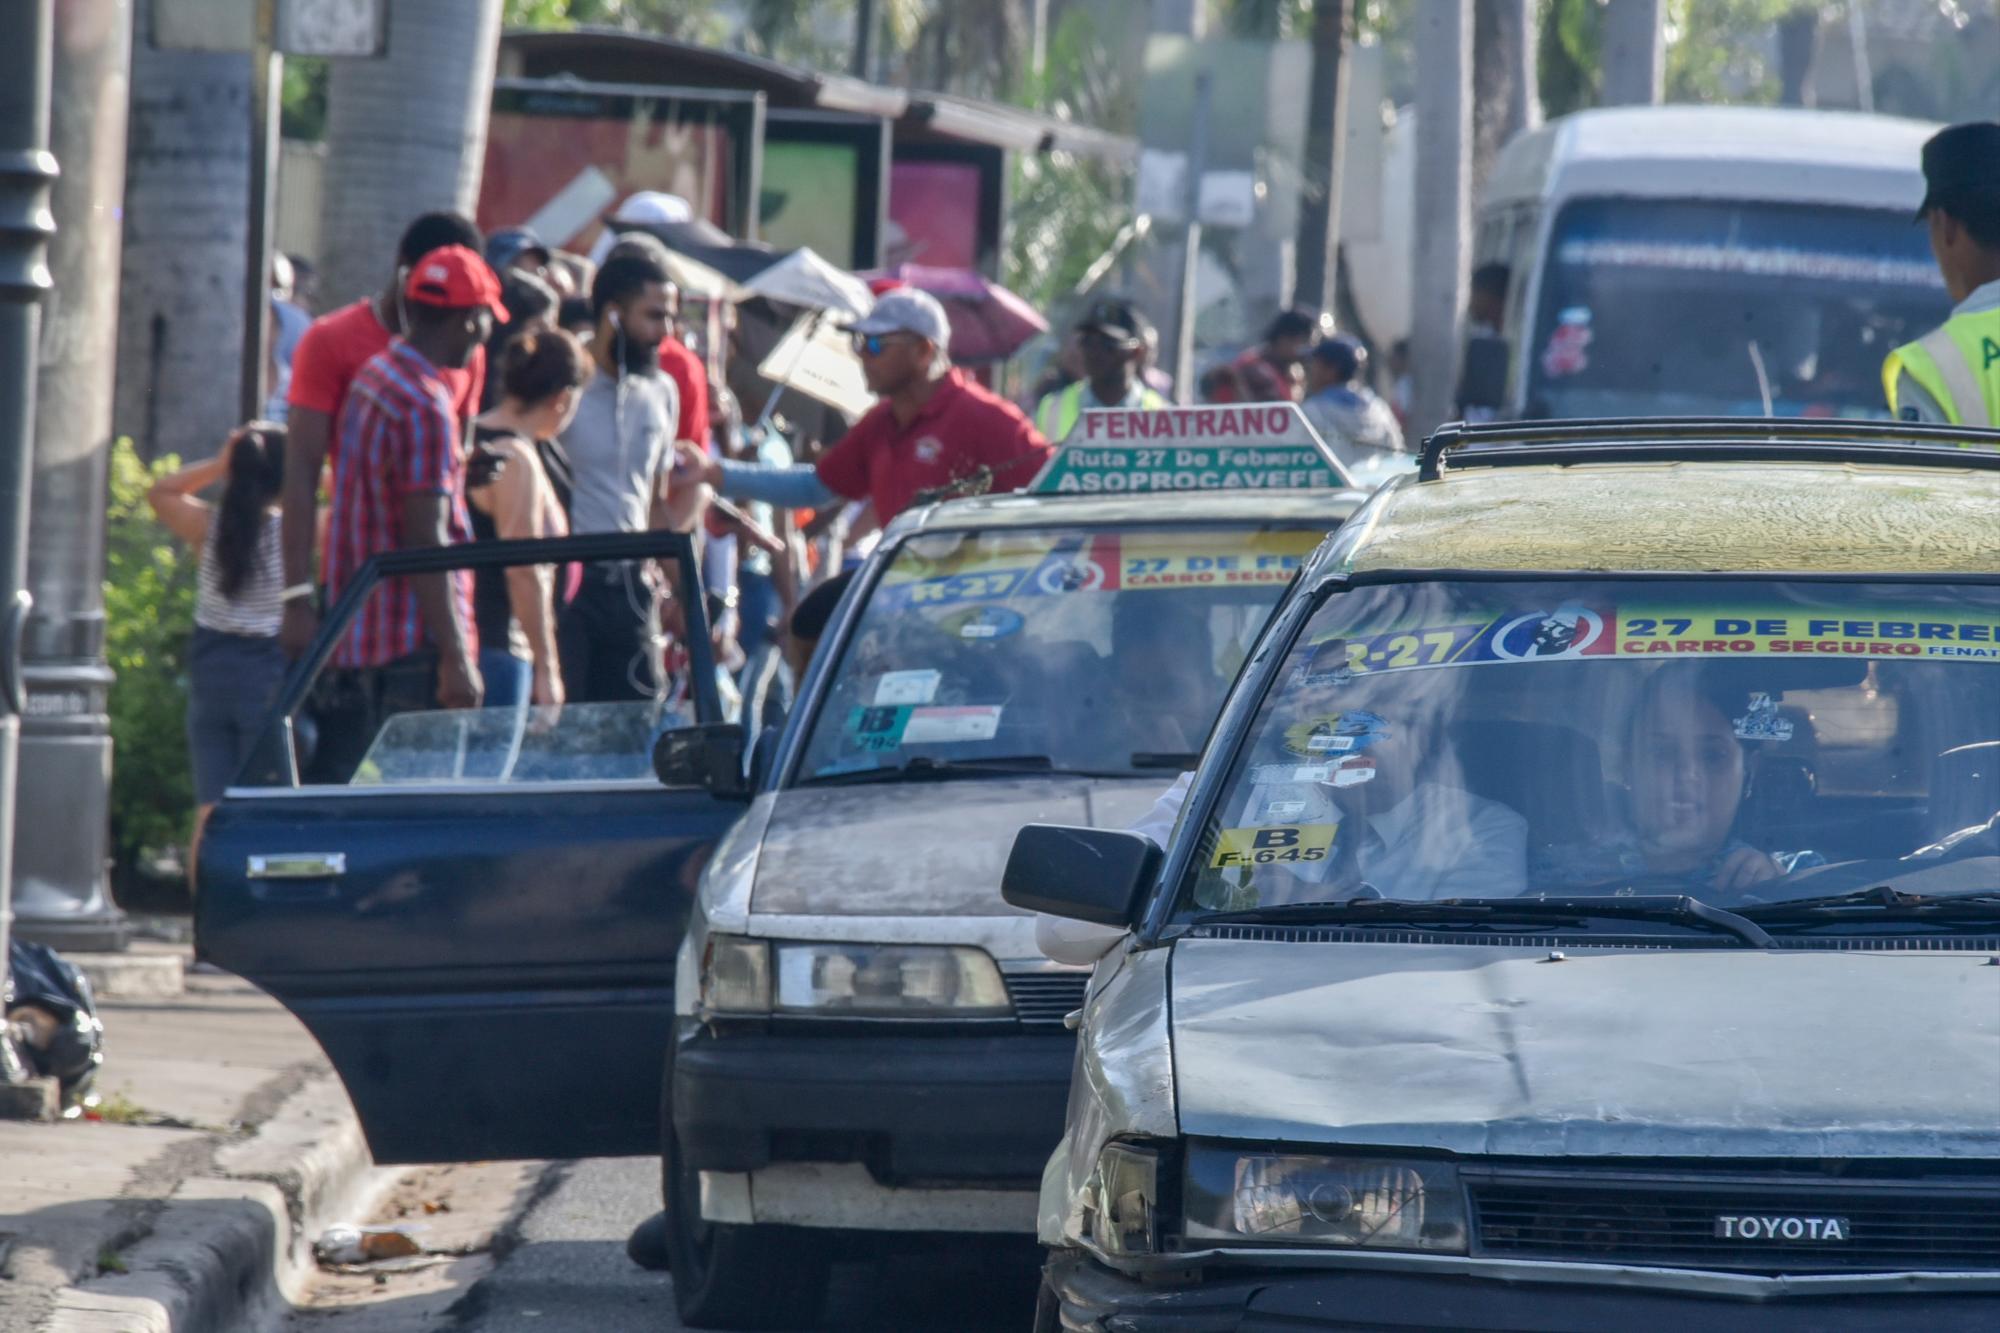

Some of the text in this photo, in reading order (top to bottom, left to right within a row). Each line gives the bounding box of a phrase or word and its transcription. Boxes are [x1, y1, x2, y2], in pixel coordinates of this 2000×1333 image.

[1086, 406, 1290, 439] FENATRANO
[1067, 448, 1127, 467] Ruta
[1135, 449, 1166, 467] 27
[1176, 448, 1209, 467] De
[1057, 470, 1330, 491] ASOPROCAVEFE
[1127, 557, 1170, 575] 27
[1186, 555, 1239, 571] DE
[911, 573, 1014, 604] R-27
[1127, 572, 1215, 585] CARRO
[1626, 618, 2000, 643] 27 DE FEBRE
[1623, 640, 1756, 654] CARRO
[1769, 640, 1921, 656] SEGURO
[1252, 828, 1299, 849] B
[1217, 847, 1325, 867] F-645
[1720, 1216, 1843, 1240] TOYOTA
